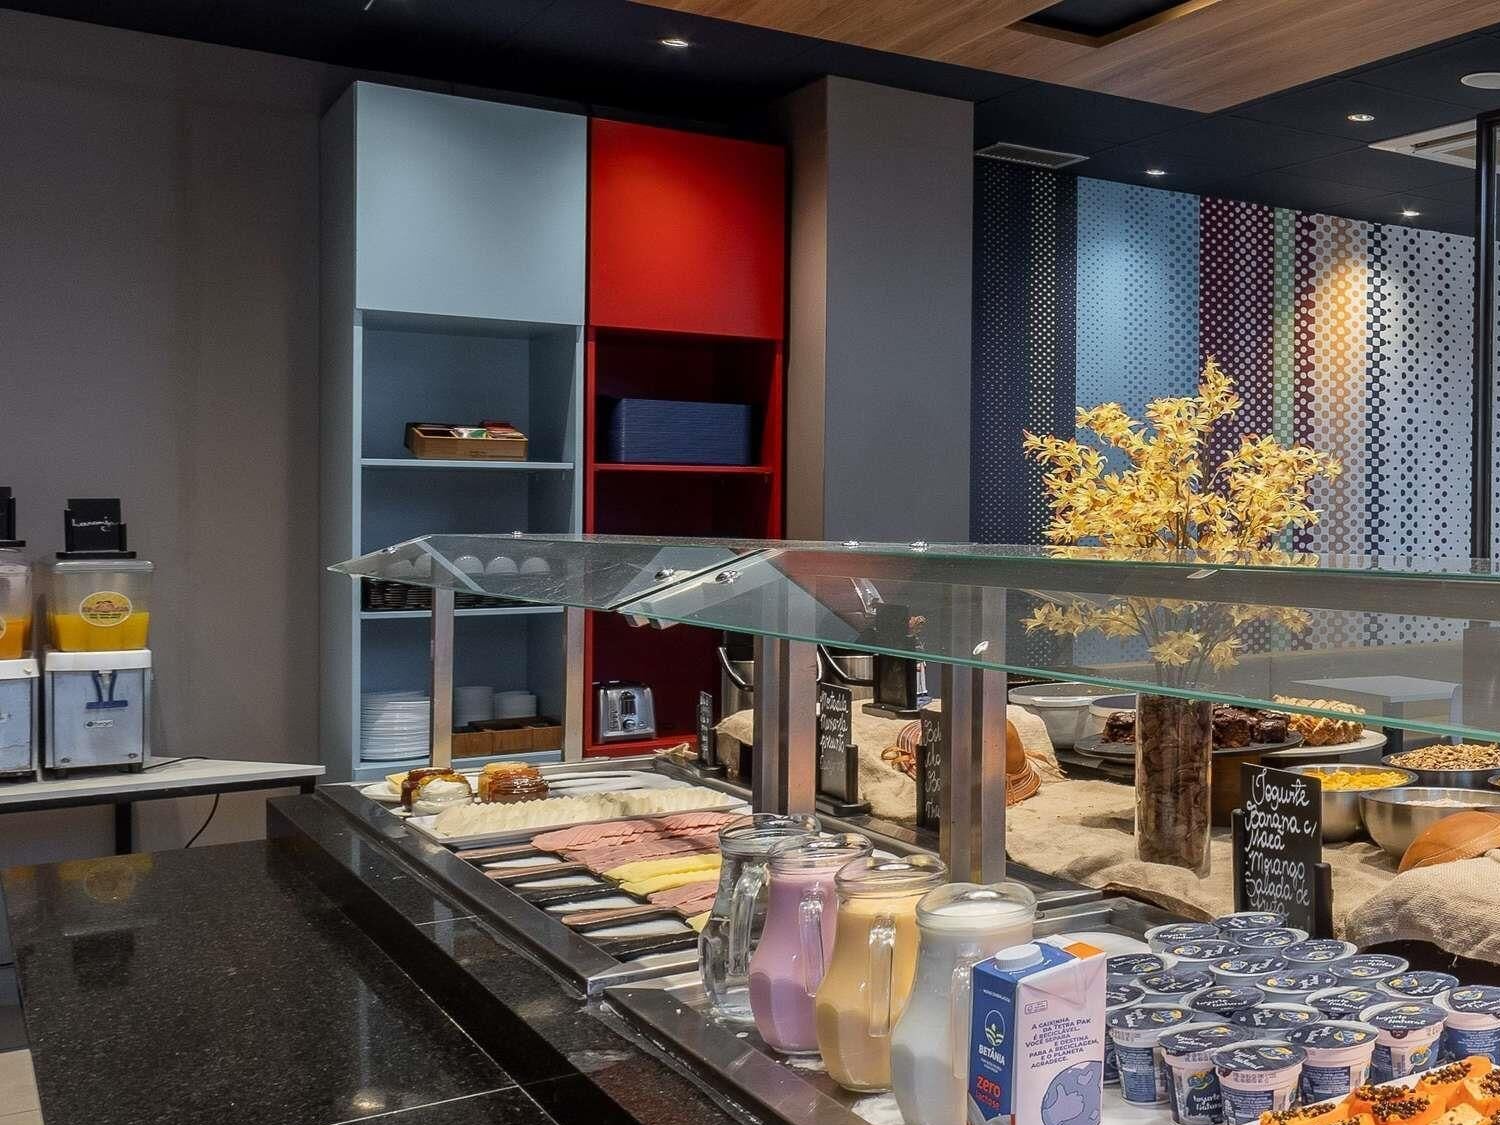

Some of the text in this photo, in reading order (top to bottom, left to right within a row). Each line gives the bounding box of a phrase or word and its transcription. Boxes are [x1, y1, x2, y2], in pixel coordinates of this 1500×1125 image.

[1244, 801, 1300, 834] Banana
[1245, 871, 1311, 906] Salada de
[1076, 1017, 1092, 1026] PAK
[978, 1044, 1006, 1066] BETÂNIA
[976, 1075, 1002, 1098] zero
